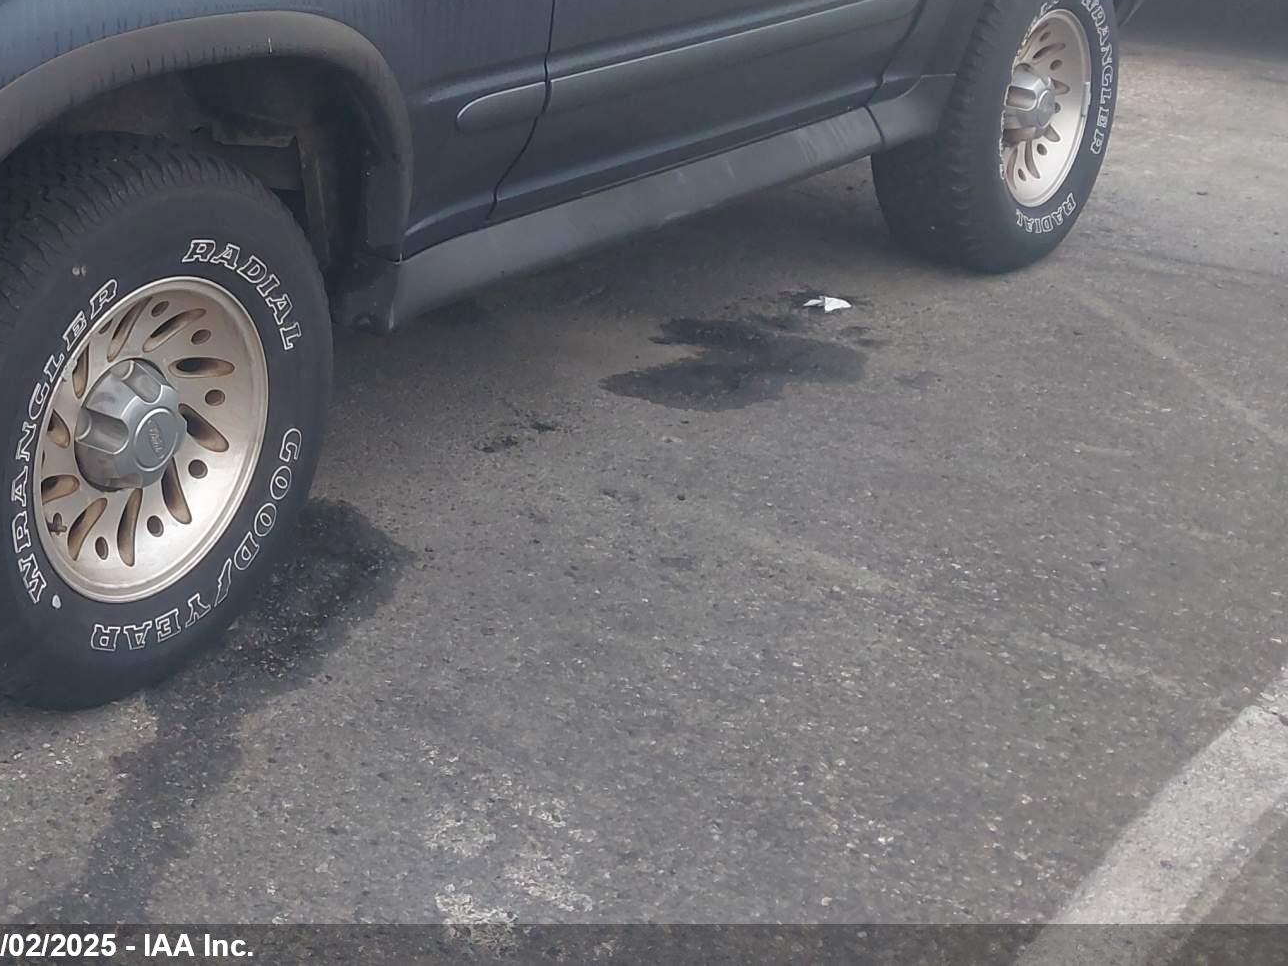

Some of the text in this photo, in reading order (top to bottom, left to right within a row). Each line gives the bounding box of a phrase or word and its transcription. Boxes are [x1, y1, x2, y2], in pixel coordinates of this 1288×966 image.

[1015, 191, 1077, 234] RADIAL
[182, 238, 305, 351] RADIAL
[11, 278, 119, 604] WRANGLER
